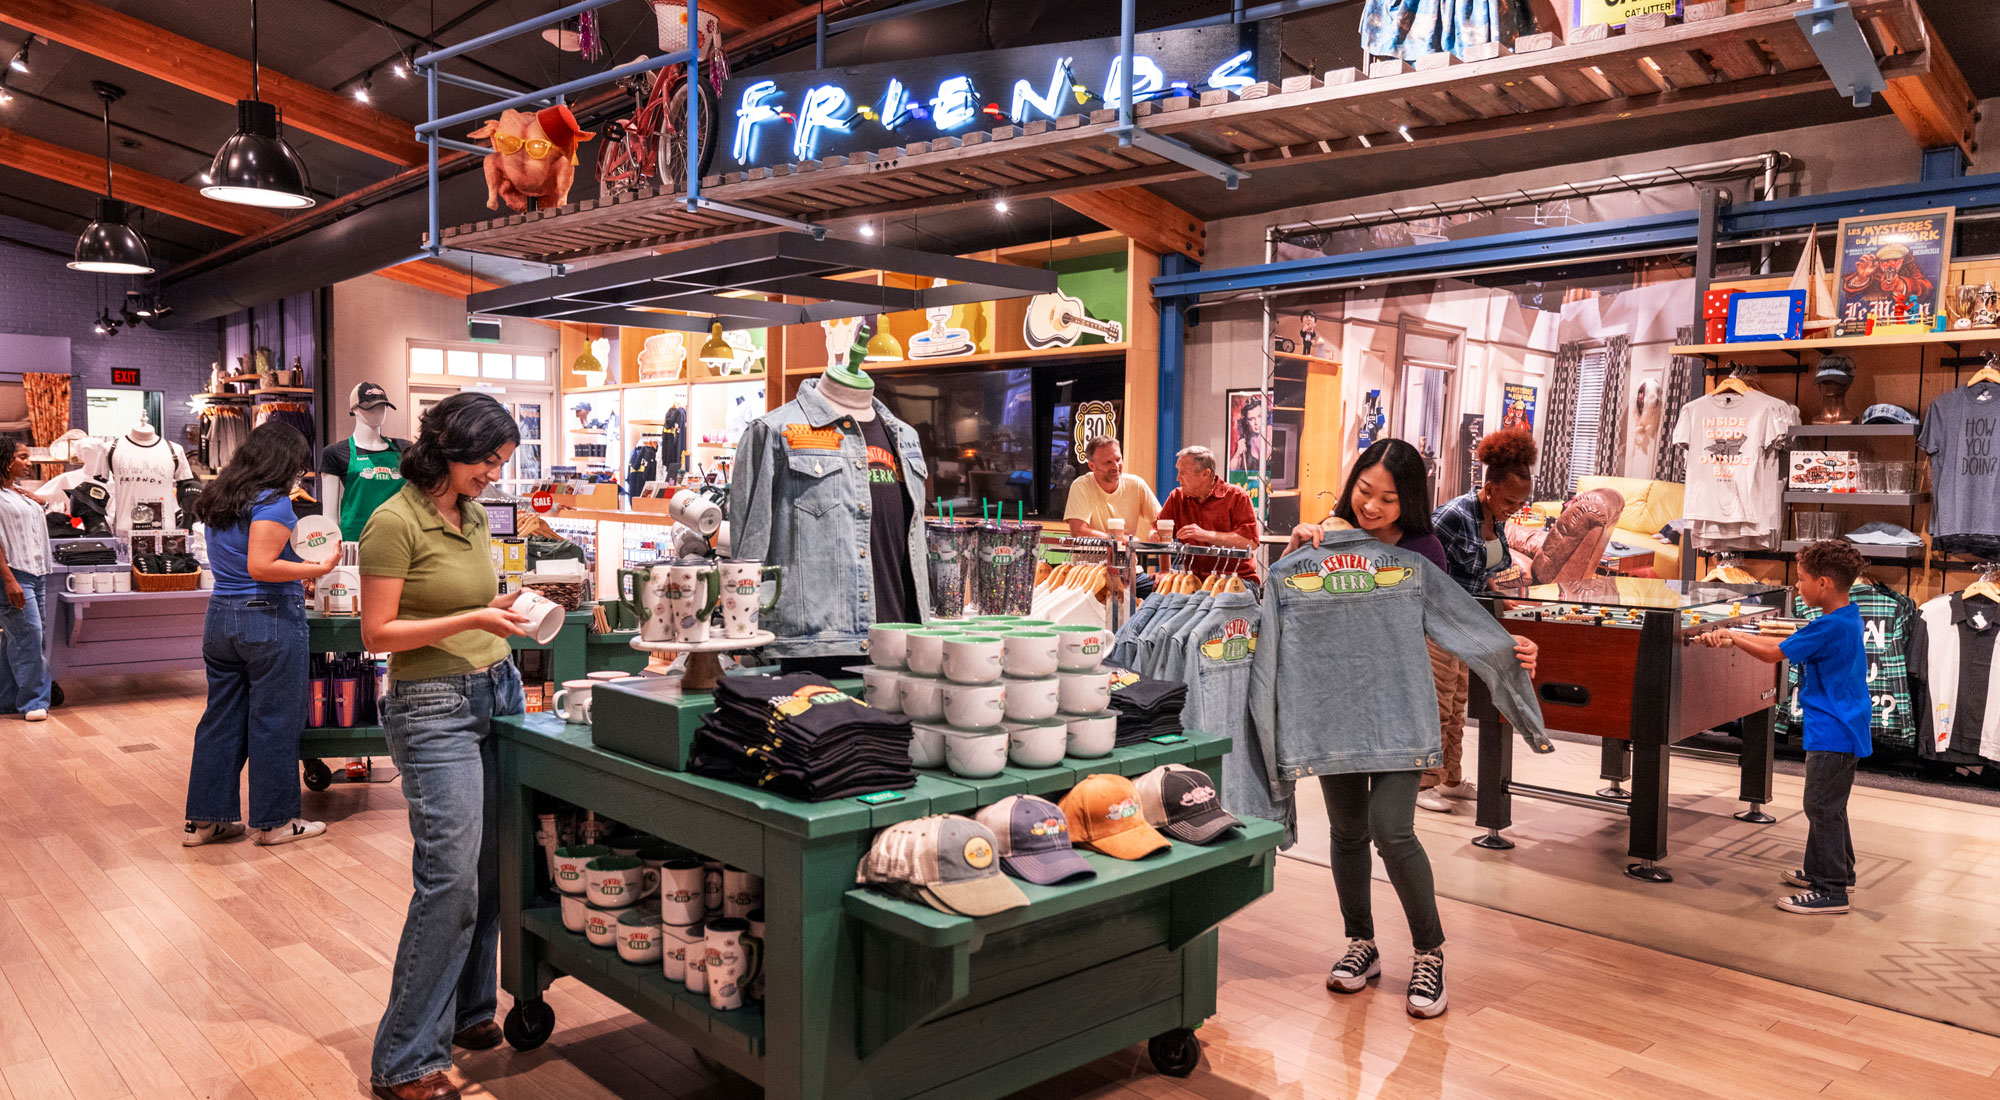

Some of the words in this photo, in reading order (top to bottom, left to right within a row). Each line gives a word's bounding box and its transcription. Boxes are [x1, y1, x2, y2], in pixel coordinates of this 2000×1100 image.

[1625, 8, 1641, 18] CAT
[1643, 2, 1671, 15] LITTER
[733, 51, 1256, 166] FRIENDS
[1847, 228, 1861, 236] LES
[114, 370, 137, 384] EXIT
[1085, 417, 1105, 442] 30
[1703, 416, 1747, 428] INSIDE
[1966, 418, 1997, 437] HOW
[1705, 429, 1744, 440] GOOD
[1966, 438, 1991, 457] YOU
[1698, 454, 1750, 466] OUTSIDE
[1961, 457, 1998, 476] DOIN?
[1712, 466, 1735, 478] BAD
[120, 476, 162, 485] FRIENDS
[533, 497, 551, 507] SALE
[1323, 554, 1369, 573] CENTRAL
[1331, 574, 1369, 591] PERK
[1225, 618, 1250, 639] CENTRAL
[1226, 640, 1245, 657] PERK
